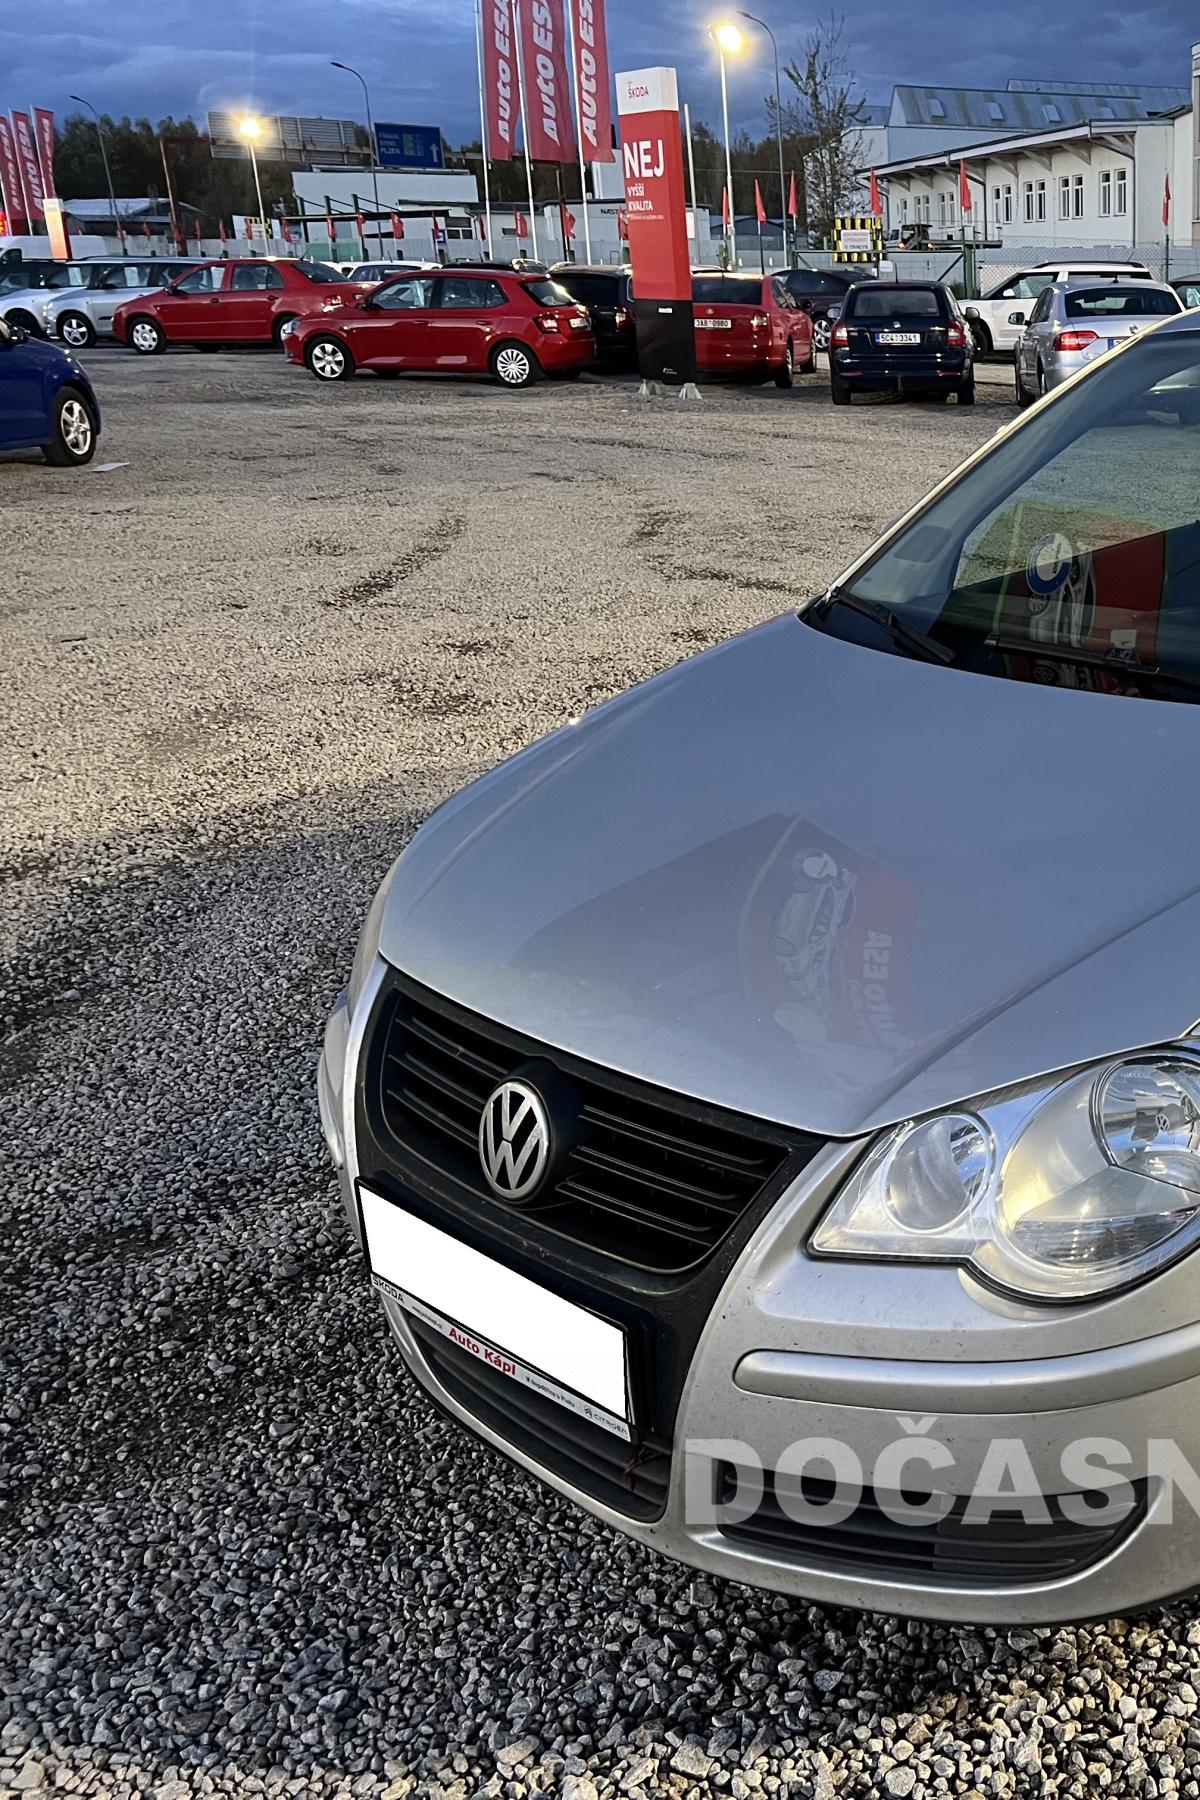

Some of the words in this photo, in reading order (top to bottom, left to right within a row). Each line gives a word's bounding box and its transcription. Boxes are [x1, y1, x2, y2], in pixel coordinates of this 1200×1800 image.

[623, 139, 665, 179] NEJ
[628, 200, 654, 212] KVALITA
[449, 1327, 480, 1354] Auto
[484, 1348, 516, 1376] Kápl
